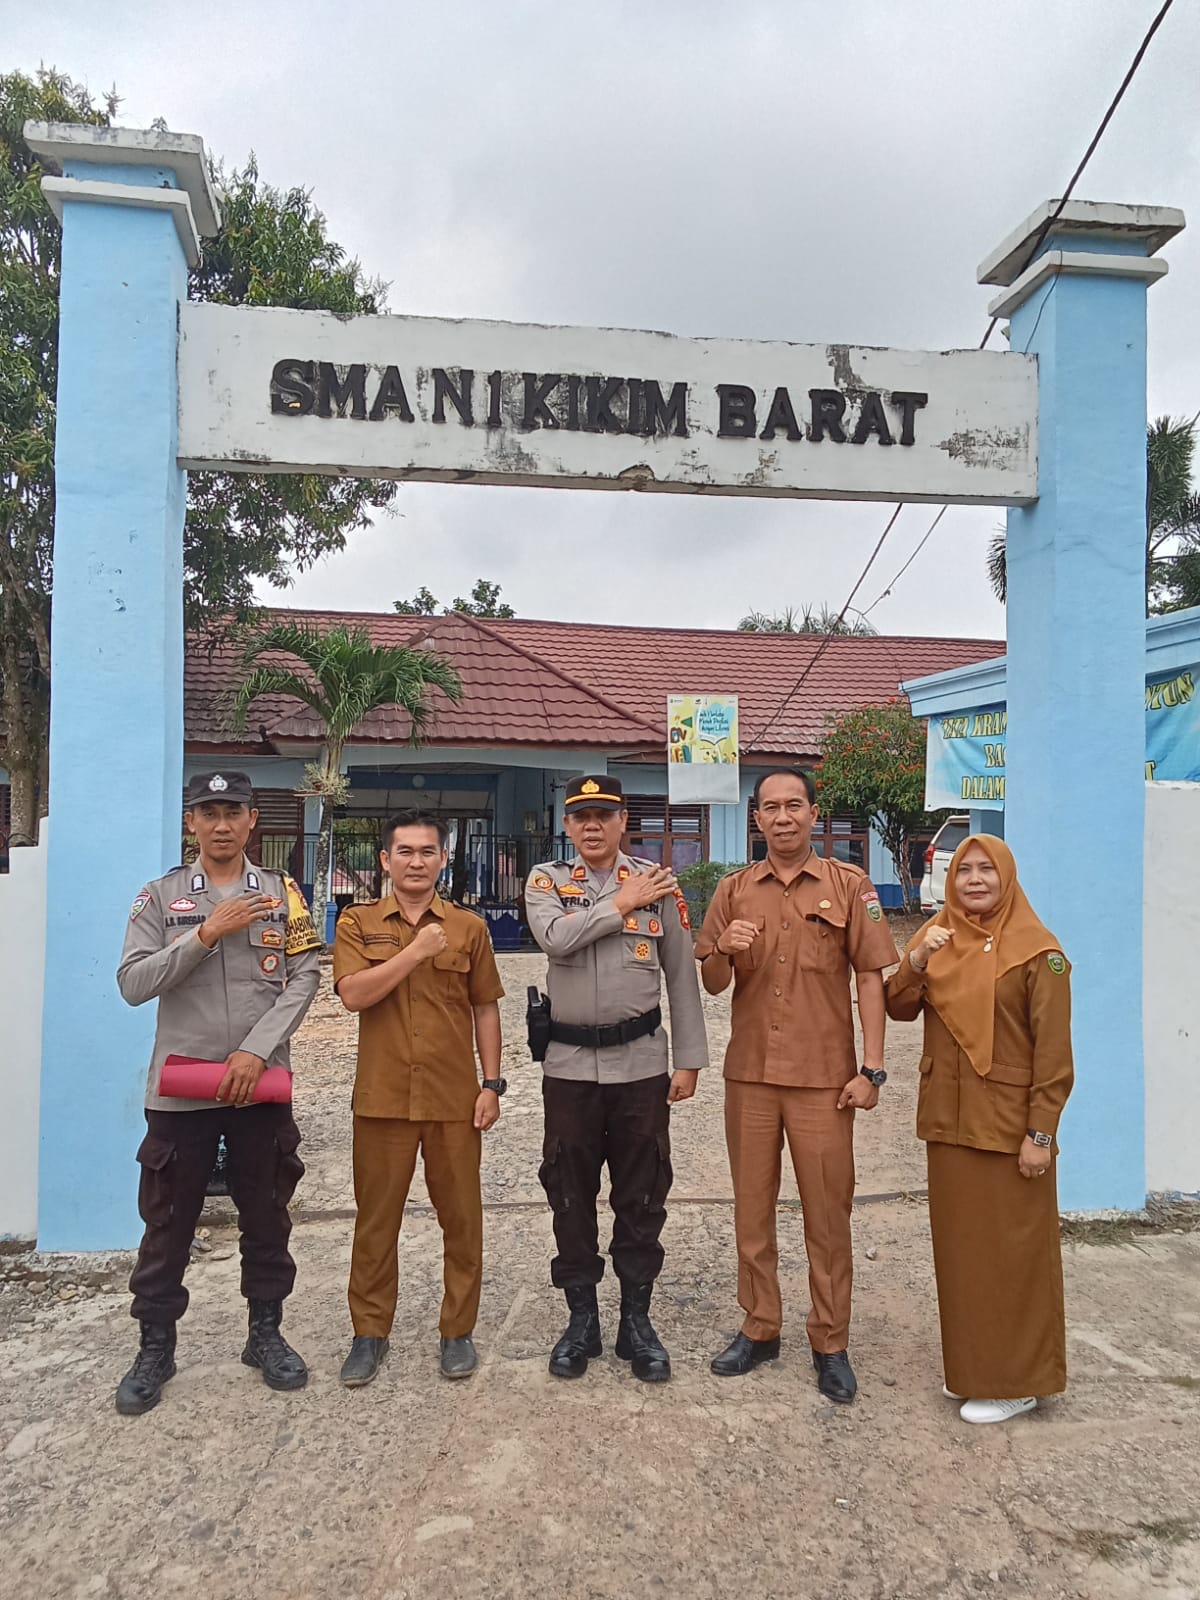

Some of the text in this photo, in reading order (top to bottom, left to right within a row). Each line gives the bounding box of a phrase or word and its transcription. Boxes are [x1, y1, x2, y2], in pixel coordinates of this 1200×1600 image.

[520, 372, 690, 437] KIKIM
[715, 383, 929, 446] BARAT
[984, 743, 1006, 768] BA
[960, 775, 1006, 800] DALAM
